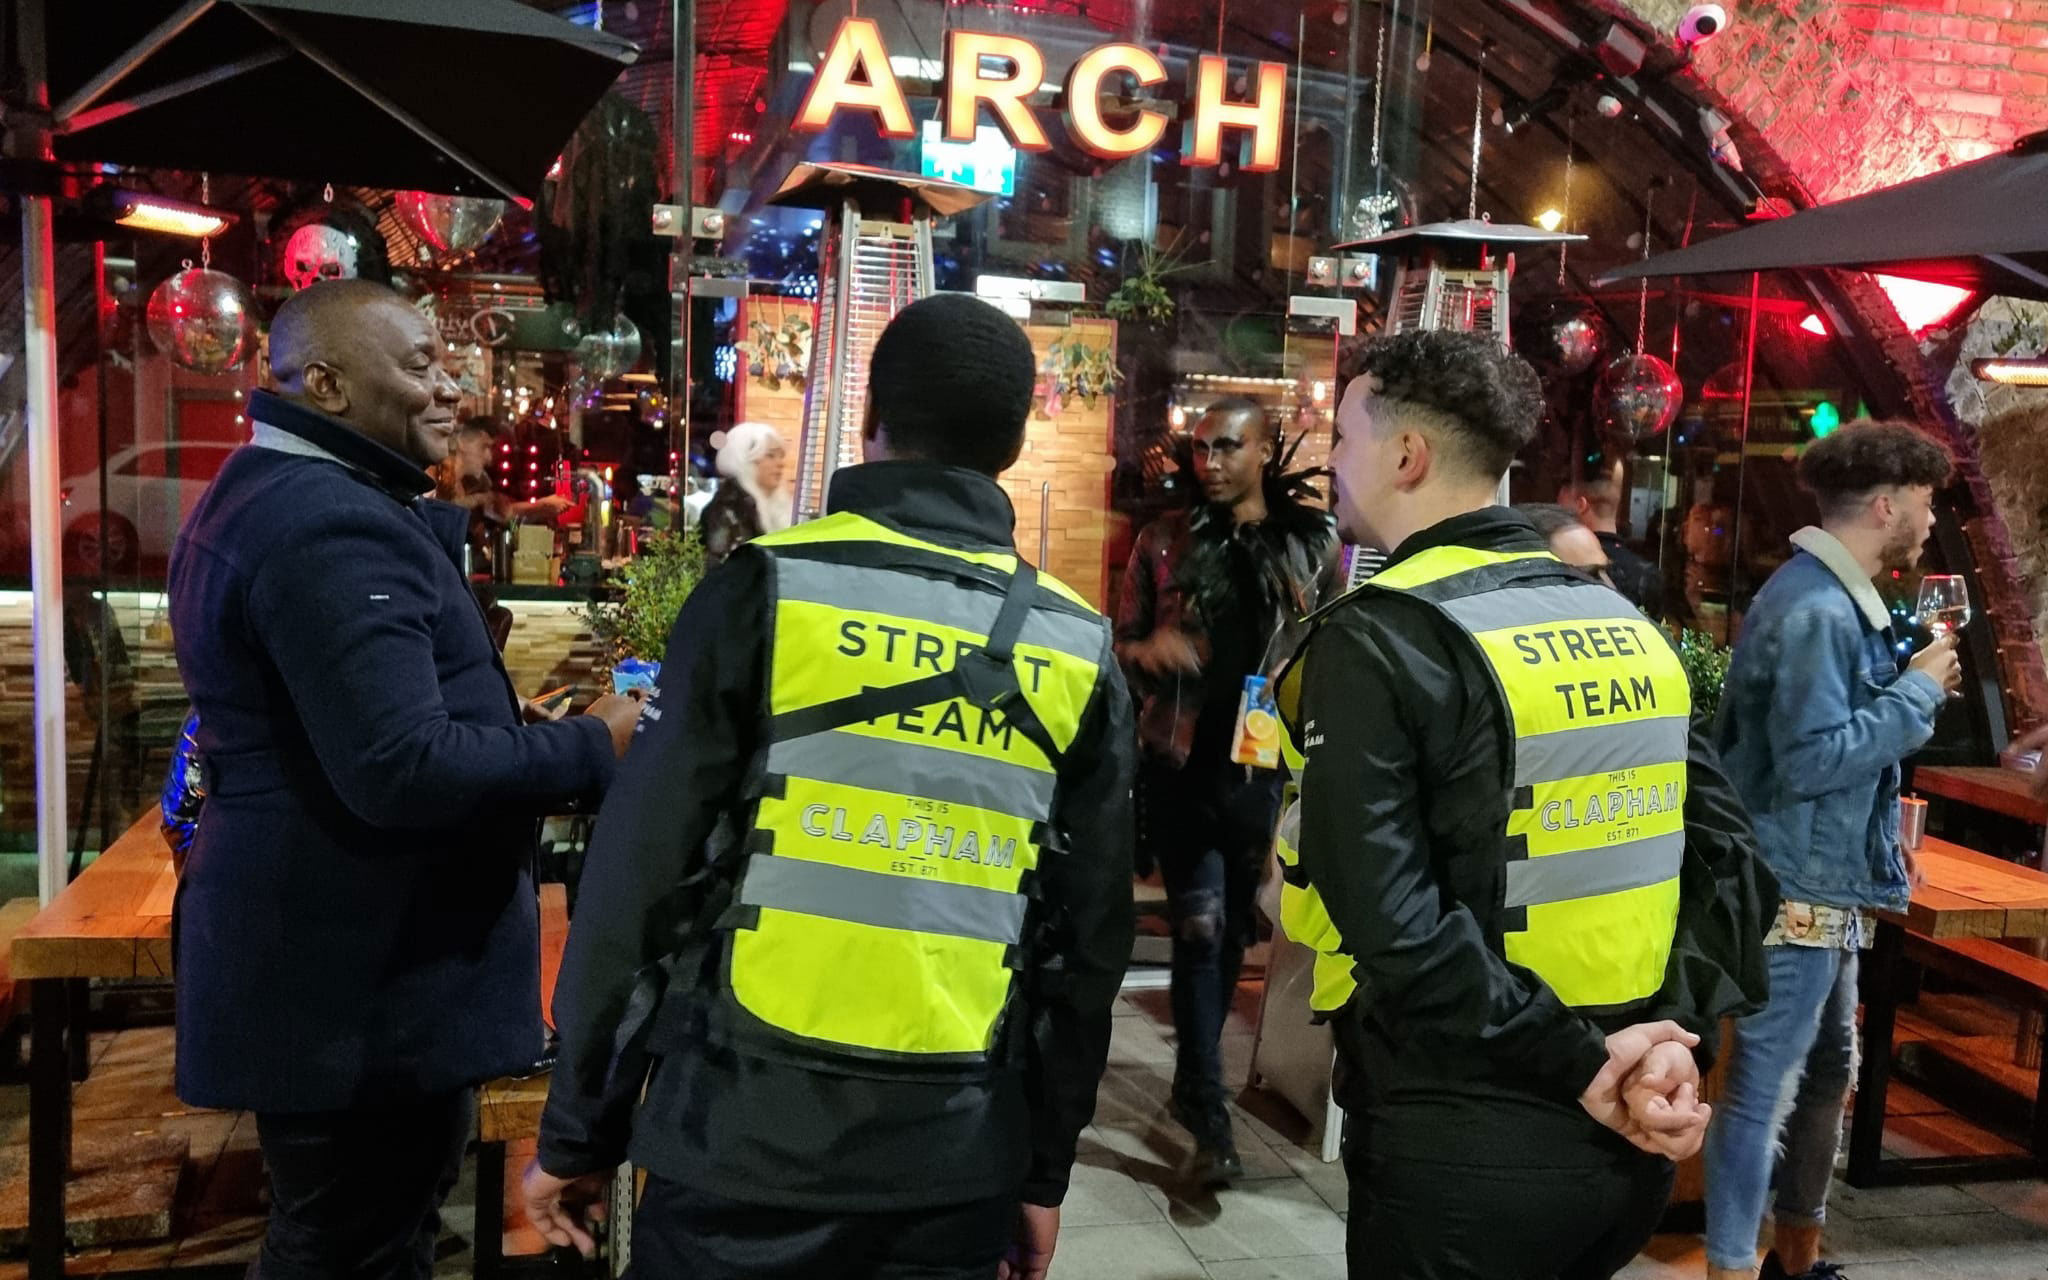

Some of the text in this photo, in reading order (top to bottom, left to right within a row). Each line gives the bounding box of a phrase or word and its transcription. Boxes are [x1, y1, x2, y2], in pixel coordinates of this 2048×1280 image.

[791, 15, 1288, 172] ARCH
[1513, 626, 1647, 665] STREET
[1554, 675, 1657, 720] TEAM
[1608, 769, 1636, 783] THIS IS
[906, 798, 949, 814] THIS IS
[1542, 782, 1679, 832] CLAPHAM
[801, 803, 1017, 869] CLAPHAM
